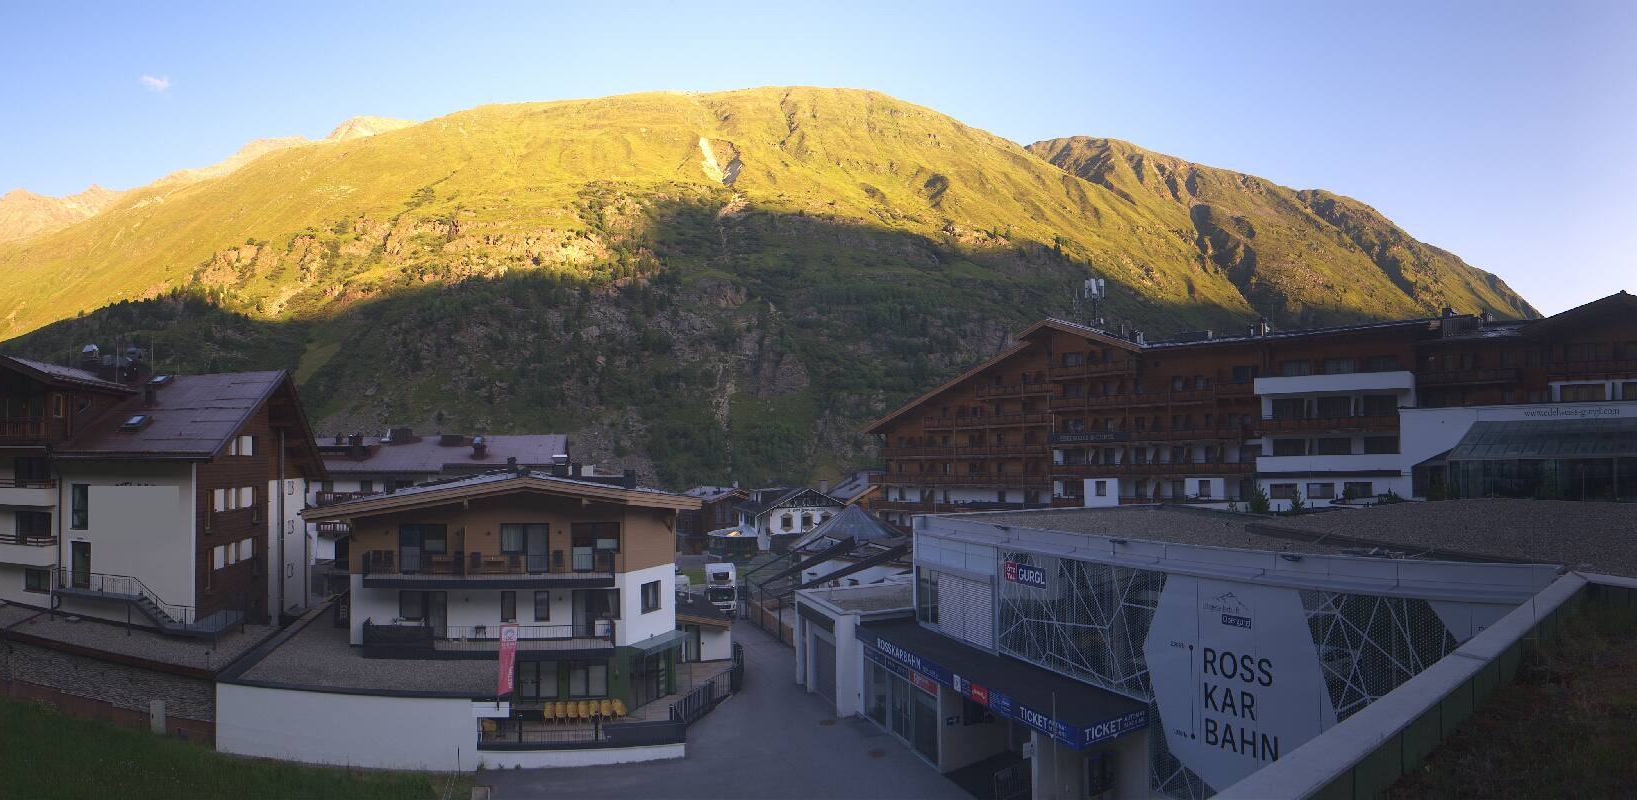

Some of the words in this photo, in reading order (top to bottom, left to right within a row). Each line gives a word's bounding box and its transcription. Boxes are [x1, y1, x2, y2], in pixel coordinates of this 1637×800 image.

[1018, 568, 1046, 585] GURGL
[877, 637, 922, 670] ROSSKARBAHN
[1203, 647, 1273, 687] ROSS
[1019, 706, 1048, 730] TICKET
[1204, 682, 1257, 721] KAR
[1084, 718, 1123, 742] TICKET
[1205, 717, 1279, 762] BAHN
